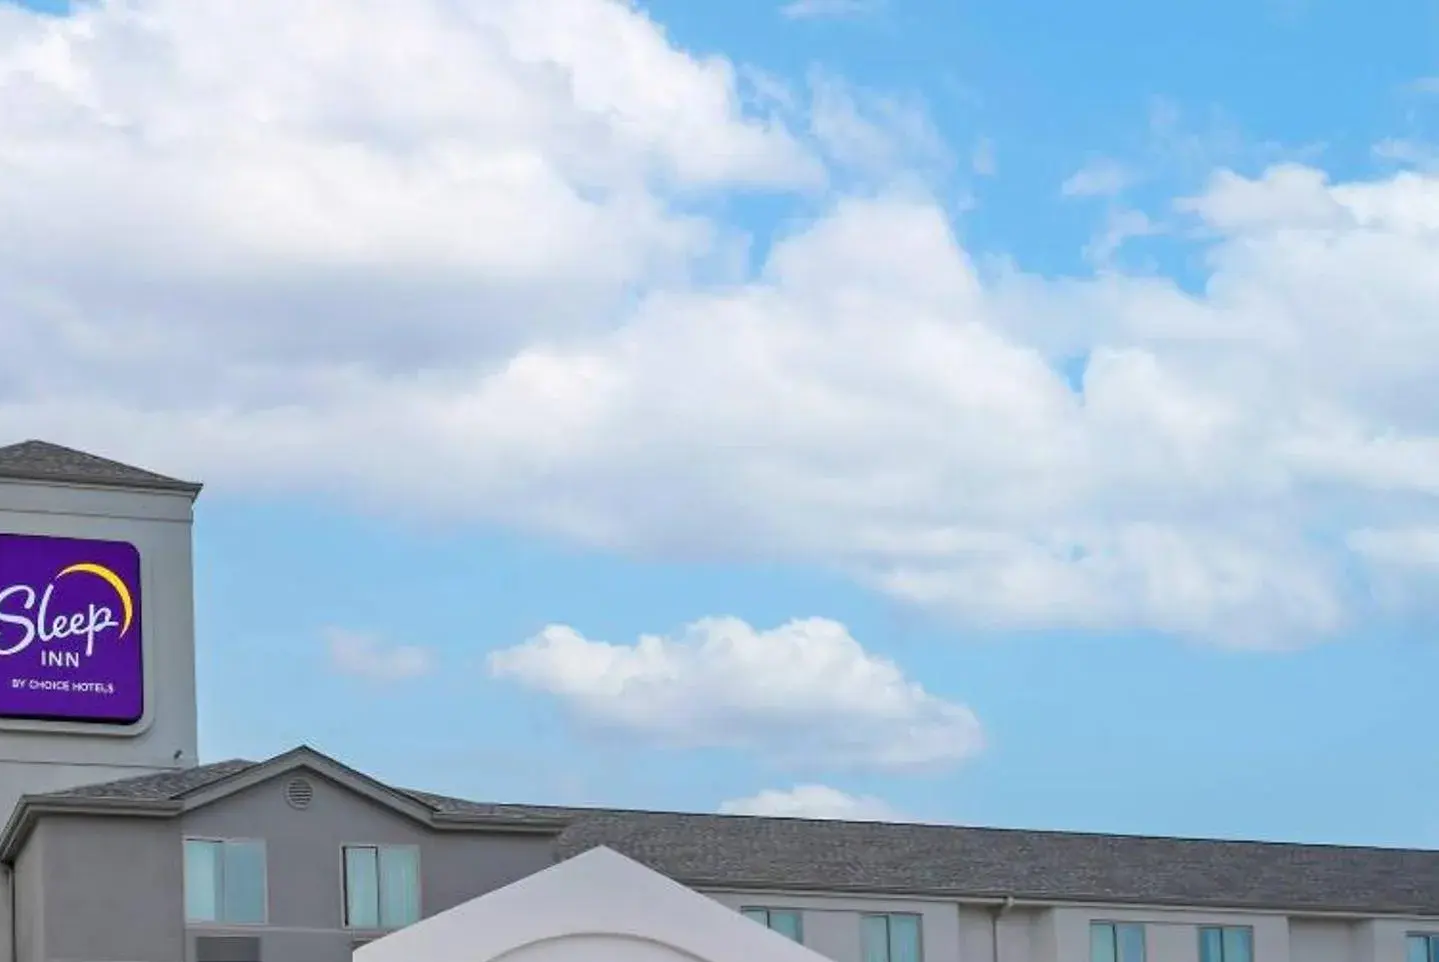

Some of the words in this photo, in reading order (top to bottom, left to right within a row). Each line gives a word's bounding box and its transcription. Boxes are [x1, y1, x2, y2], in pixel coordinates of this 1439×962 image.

[41, 650, 80, 668] INN
[12, 679, 26, 688] BY
[29, 680, 70, 691] CHOICE
[72, 682, 114, 694] HOTELS
